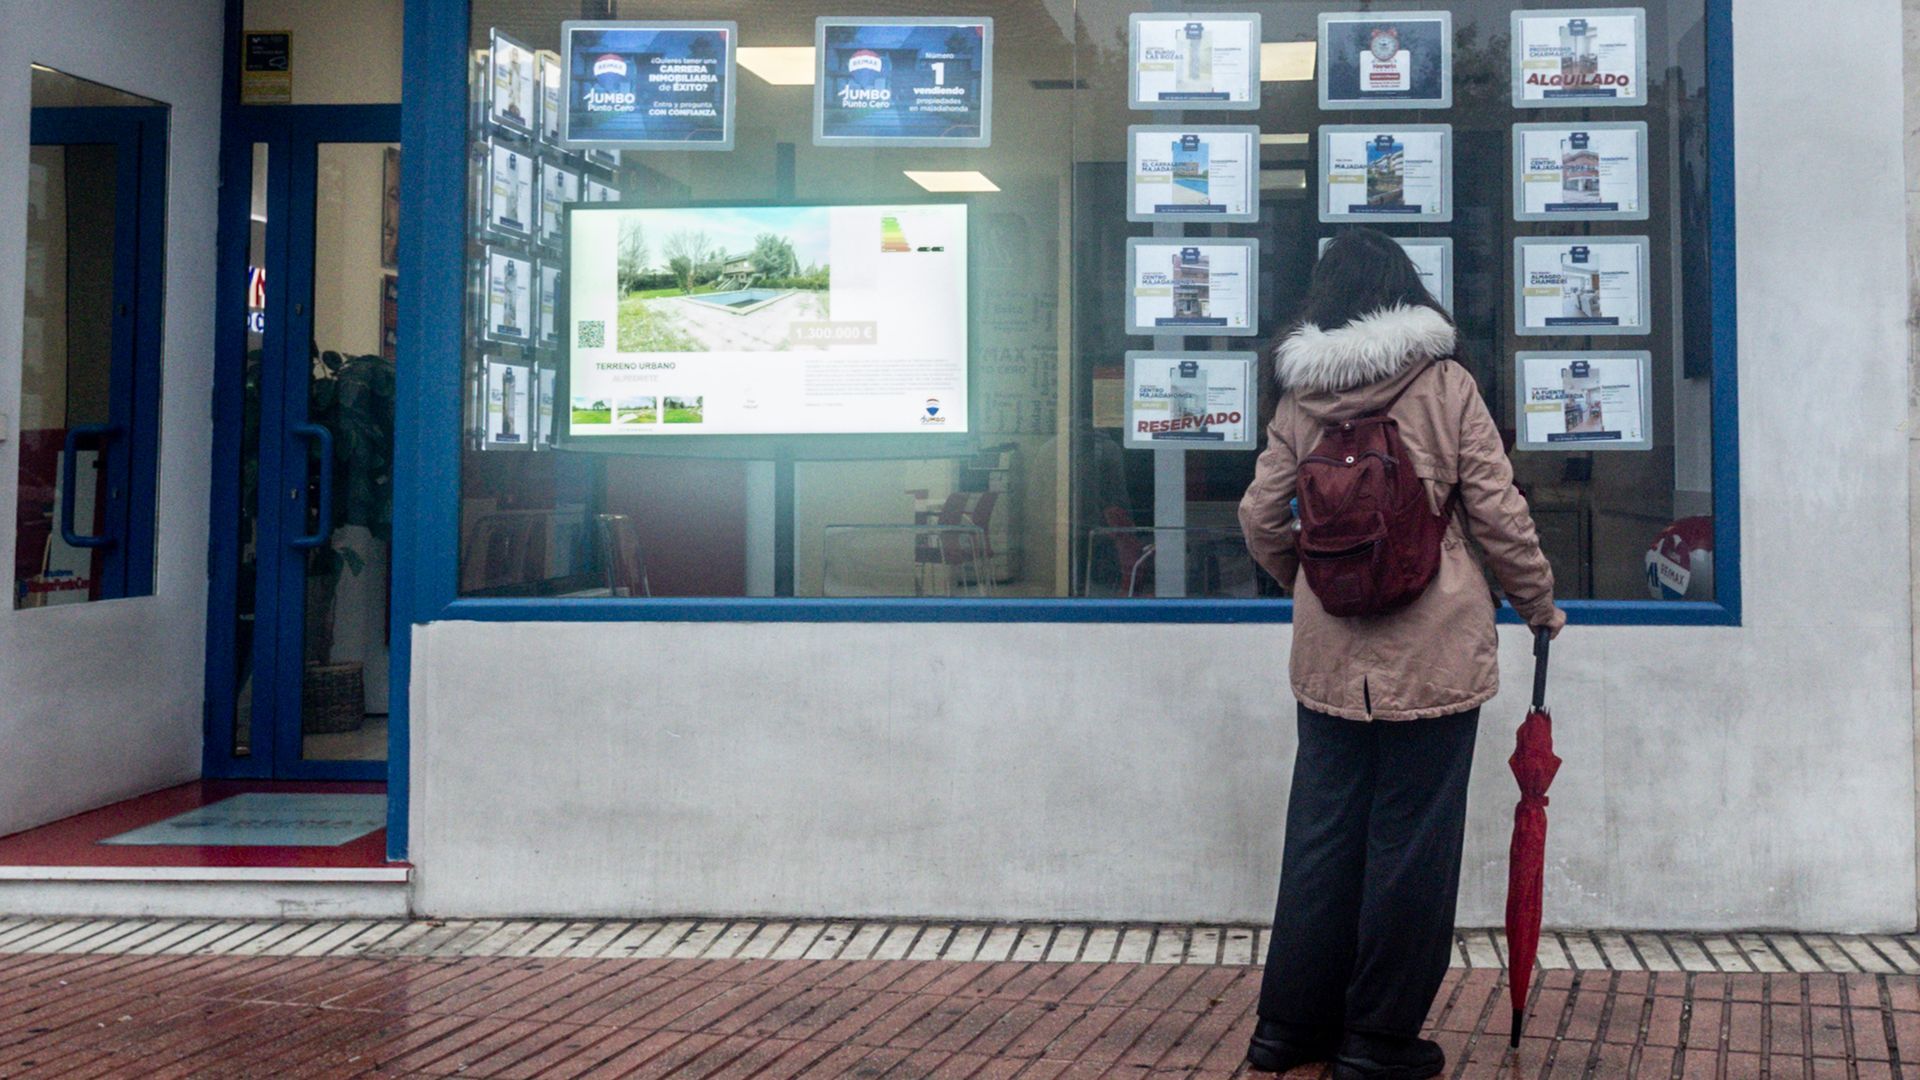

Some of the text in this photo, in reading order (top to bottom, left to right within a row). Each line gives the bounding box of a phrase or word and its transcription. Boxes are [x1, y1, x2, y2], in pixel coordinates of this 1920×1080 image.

[660, 65, 708, 73] CARRERA
[931, 62, 944, 85] 1
[649, 74, 718, 82] INMOBILIARIA
[1526, 72, 1629, 86] ALQUILADO
[673, 82, 708, 91] ÉXITO?
[913, 87, 965, 95] vendiendo
[583, 87, 635, 104] JUMBO
[838, 84, 891, 100] JUMBO
[588, 104, 635, 112] Punto Cero
[842, 100, 890, 108] Punto Cero
[796, 326, 873, 339] 1.300.000 €
[596, 362, 676, 370] TERRENO URBANO
[1137, 411, 1241, 433] RESERVADO
